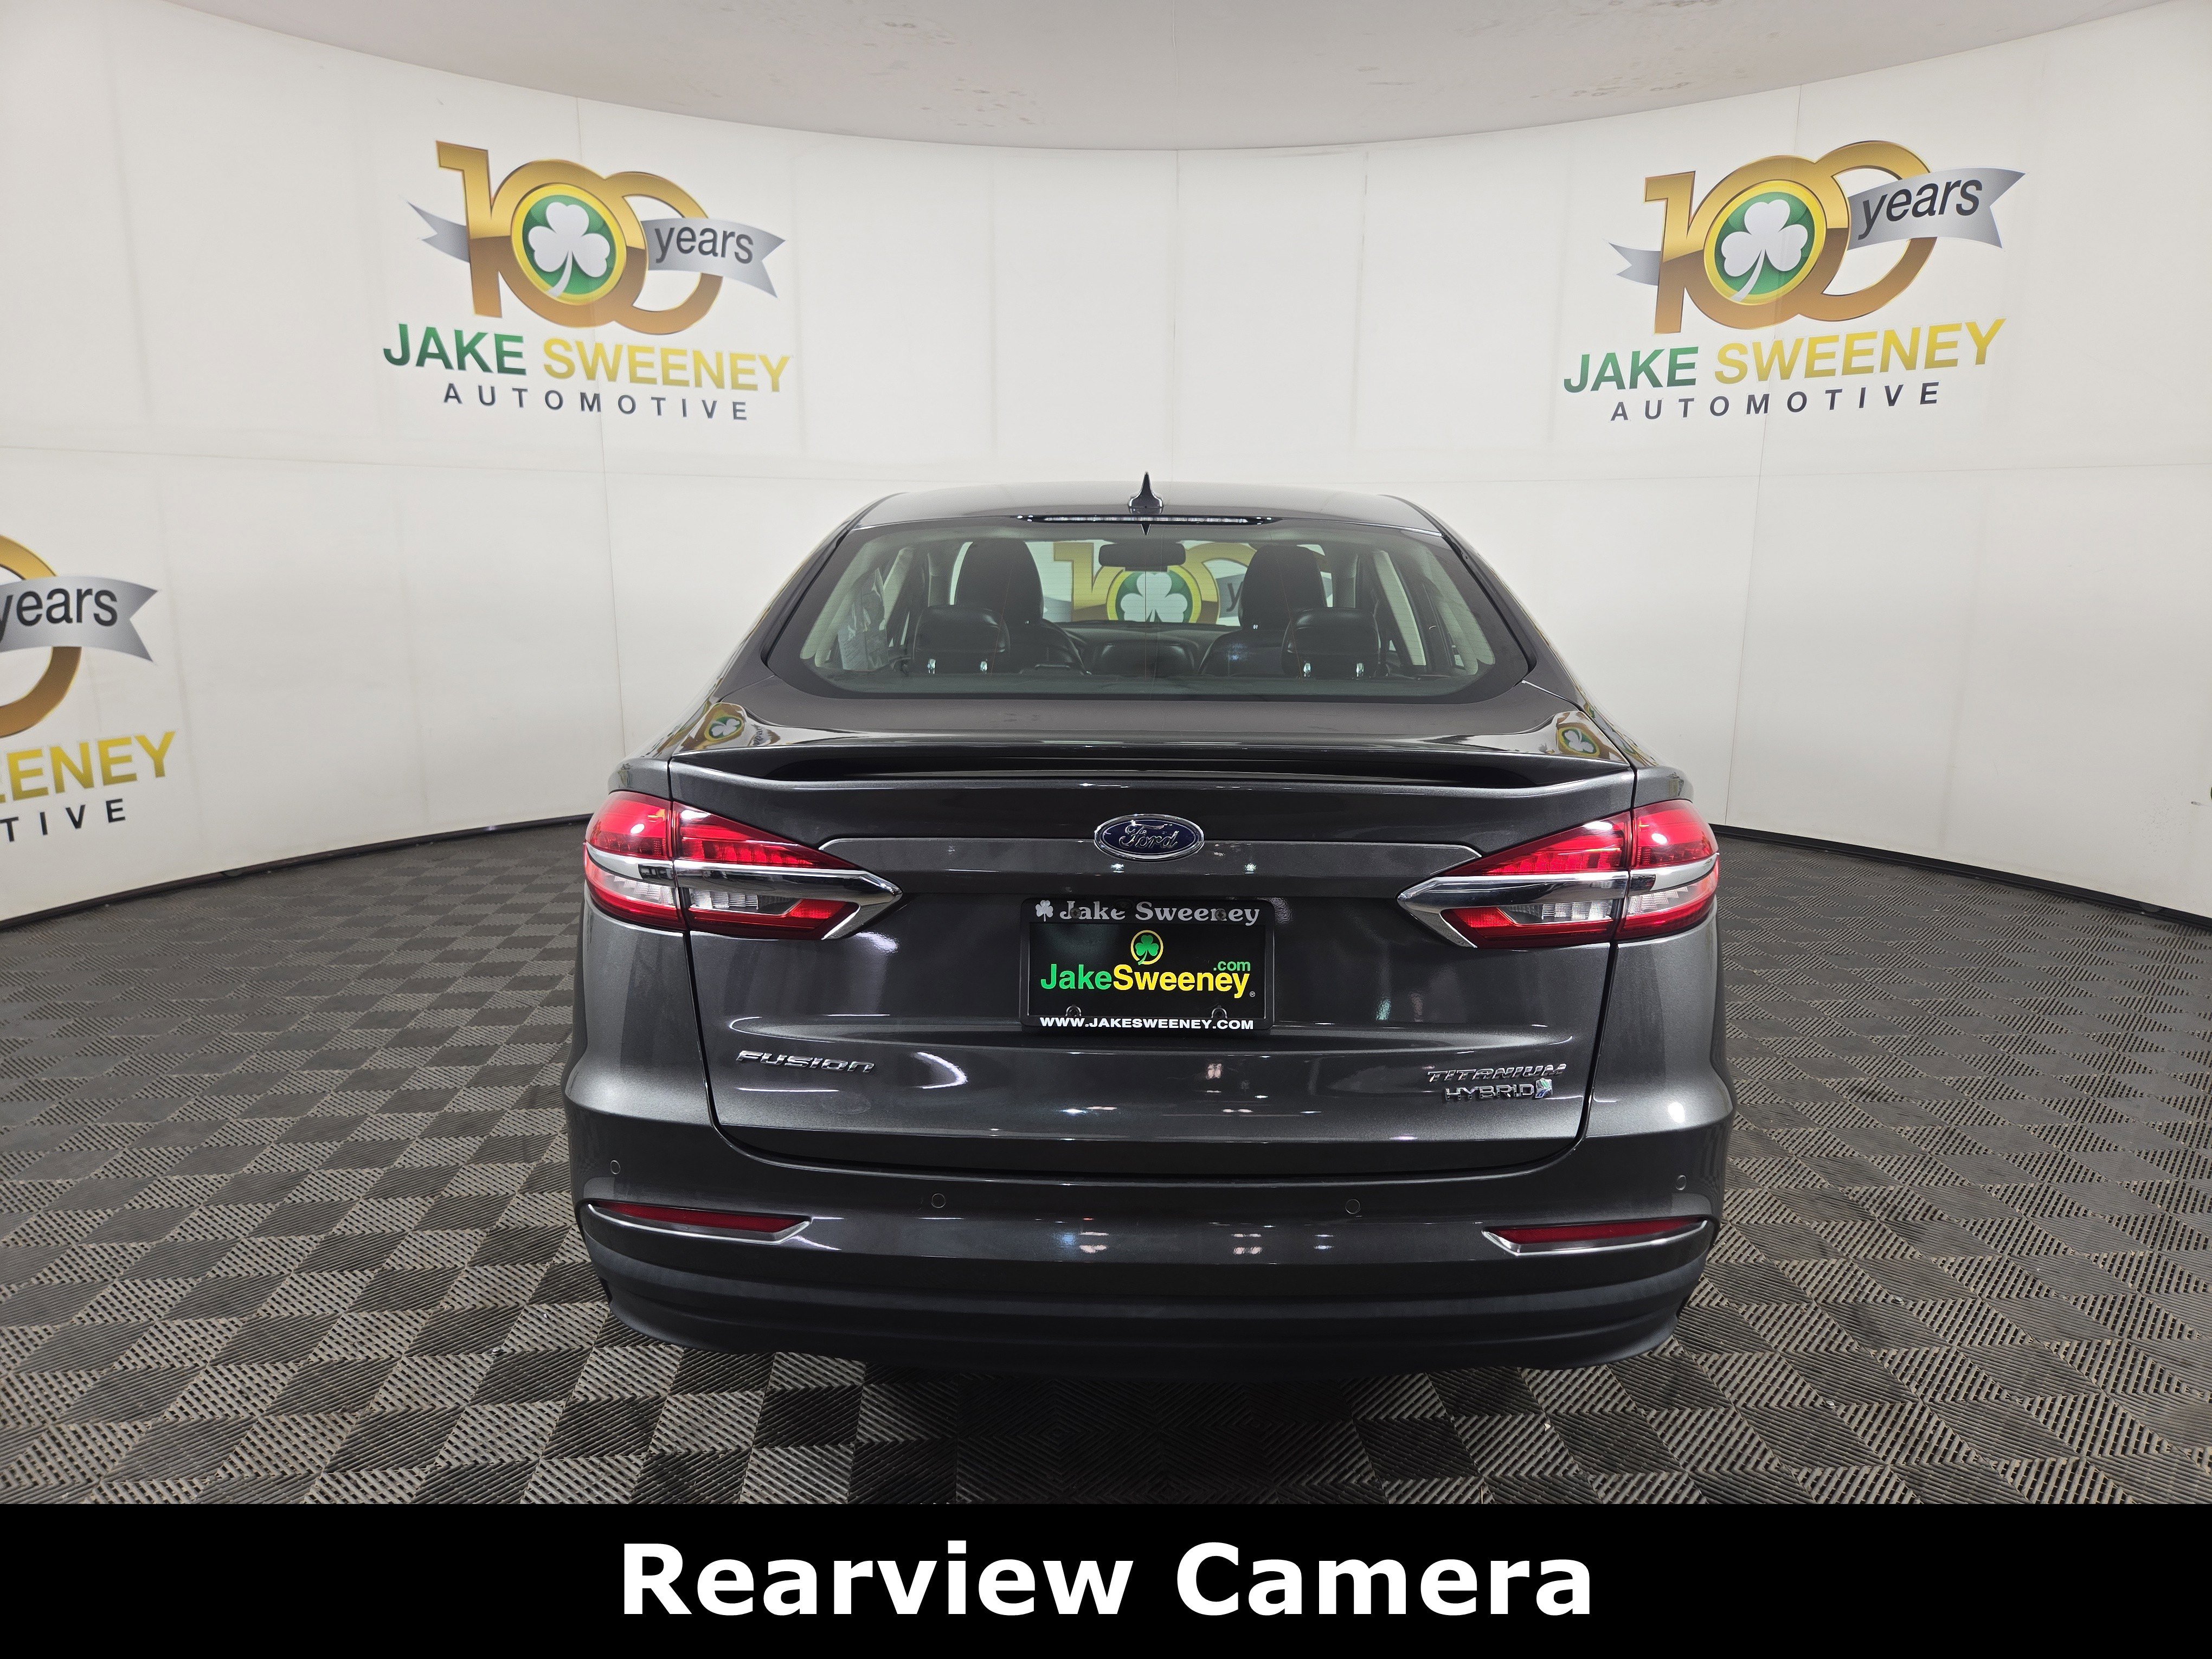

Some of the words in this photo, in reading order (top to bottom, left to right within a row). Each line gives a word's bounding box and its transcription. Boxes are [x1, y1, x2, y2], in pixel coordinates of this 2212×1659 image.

[1857, 178, 1983, 241] years
[435, 140, 723, 335] 100
[654, 226, 754, 264] years
[1643, 140, 1938, 335] 100
[383, 324, 527, 375] JAKE
[543, 337, 790, 392] SWEENEY
[1564, 346, 1699, 393] JAKE
[1714, 318, 2005, 384] SWEENEY
[443, 383, 747, 420] AUTOMOTIVE
[1610, 382, 1940, 421] AUTOMOTIVE
[0, 731, 176, 803] ENEY
[1119, 821, 1179, 850] Ford
[1059, 901, 1126, 920] Jake
[1040, 964, 1250, 999] JakeSweeney
[1213, 961, 1251, 971] .com
[1040, 1017, 1253, 1030] WWW.JAKESWEENEY.COM
[736, 1050, 874, 1073] FUSION
[1427, 1063, 1567, 1083] TITANIUM
[1444, 1084, 1534, 1101] HYBRID
